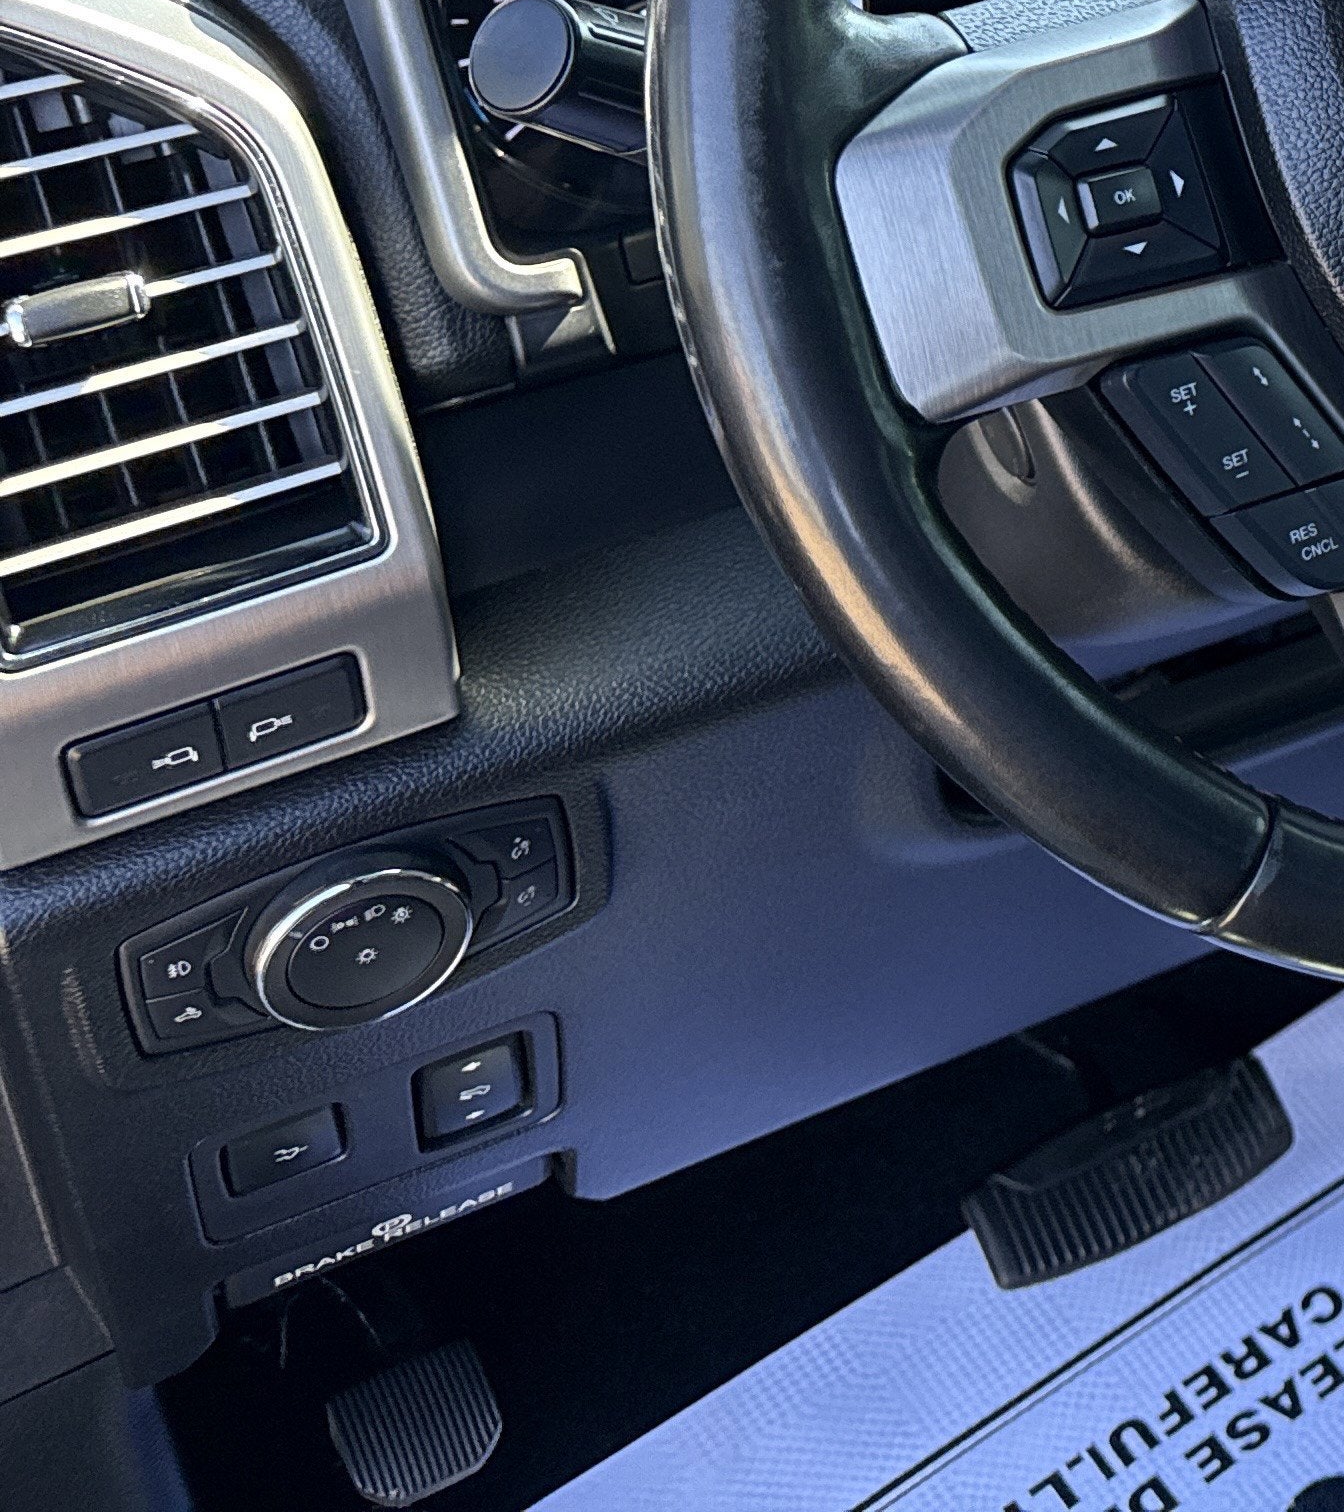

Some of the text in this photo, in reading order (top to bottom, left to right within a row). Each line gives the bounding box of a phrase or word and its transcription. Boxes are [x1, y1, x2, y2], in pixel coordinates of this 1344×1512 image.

[1113, 189, 1137, 205] OK
[1170, 382, 1198, 403] SET
[1222, 448, 1249, 471] SET
[1289, 522, 1318, 544] RES
[1301, 537, 1339, 561] CNCL
[273, 1181, 513, 1288] BRAKE RELEASE
[1003, 1285, 1343, 1512] CAREFULL
